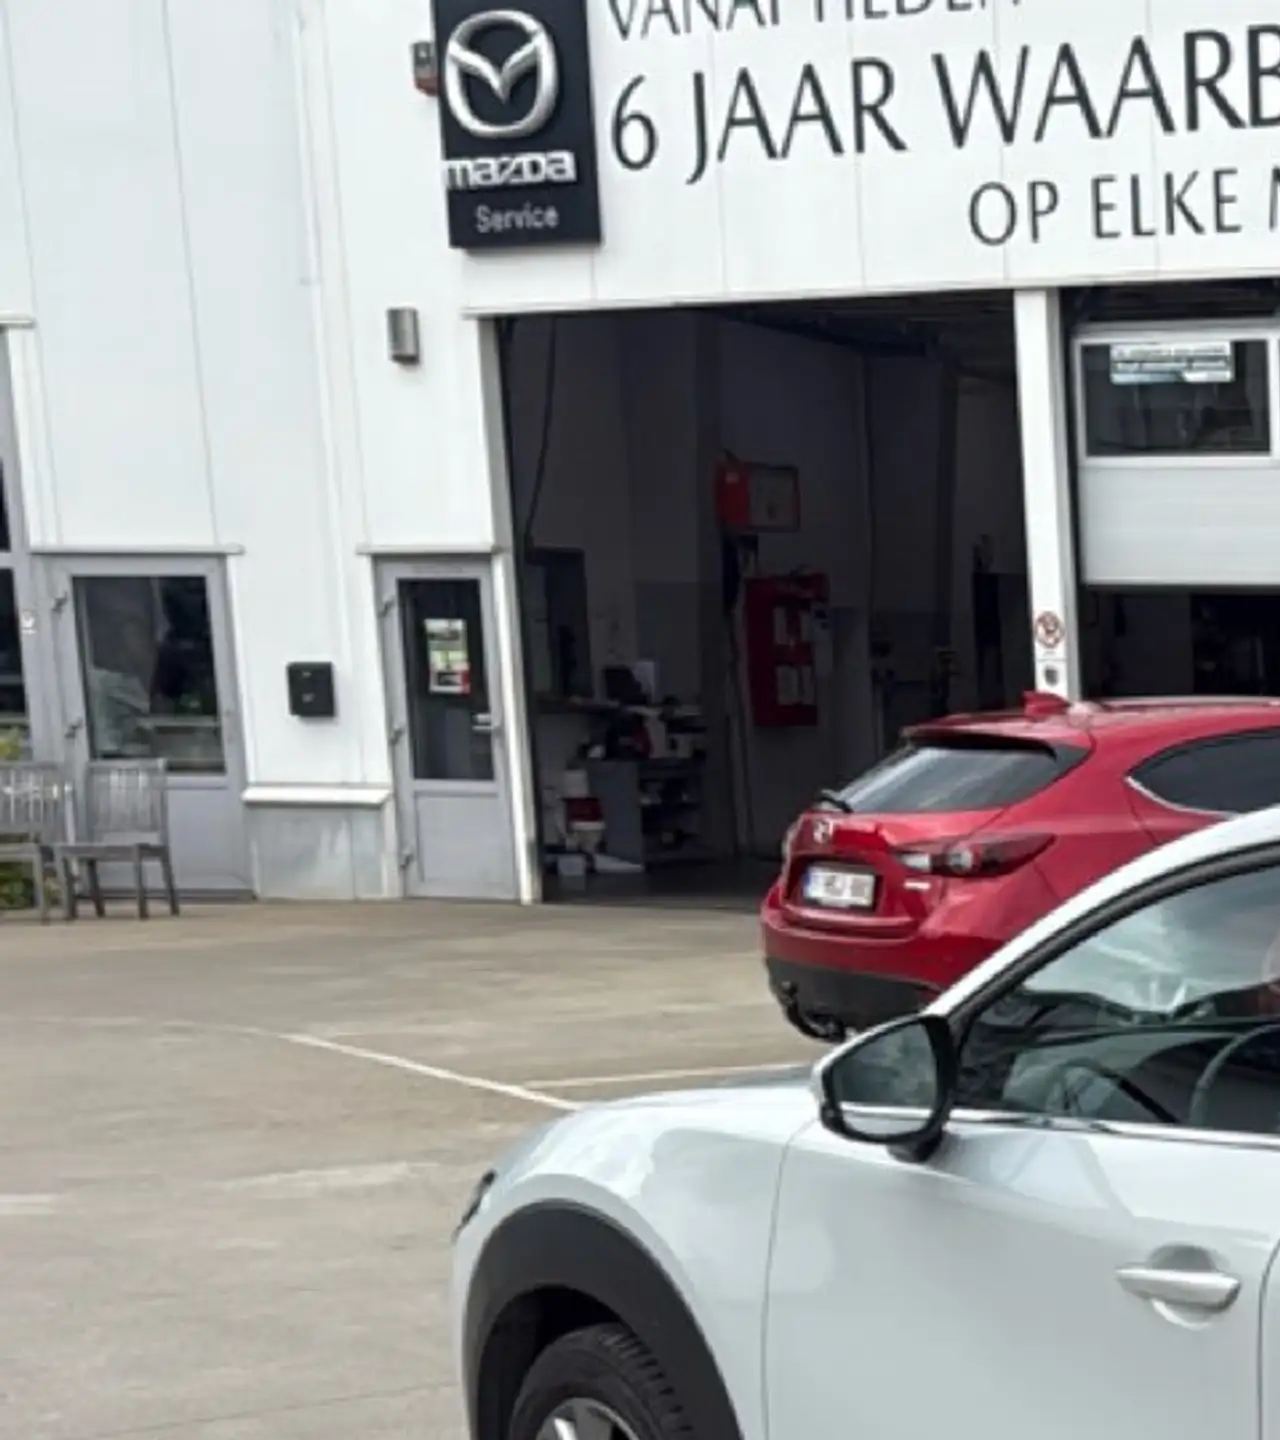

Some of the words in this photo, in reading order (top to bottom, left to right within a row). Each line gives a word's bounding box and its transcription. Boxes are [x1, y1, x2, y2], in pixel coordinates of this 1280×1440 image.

[610, 74, 660, 171] 6
[685, 56, 910, 186] JAAR
[474, 201, 561, 234] Service
[967, 181, 1061, 247] OP
[1089, 168, 1242, 240] ELKE
